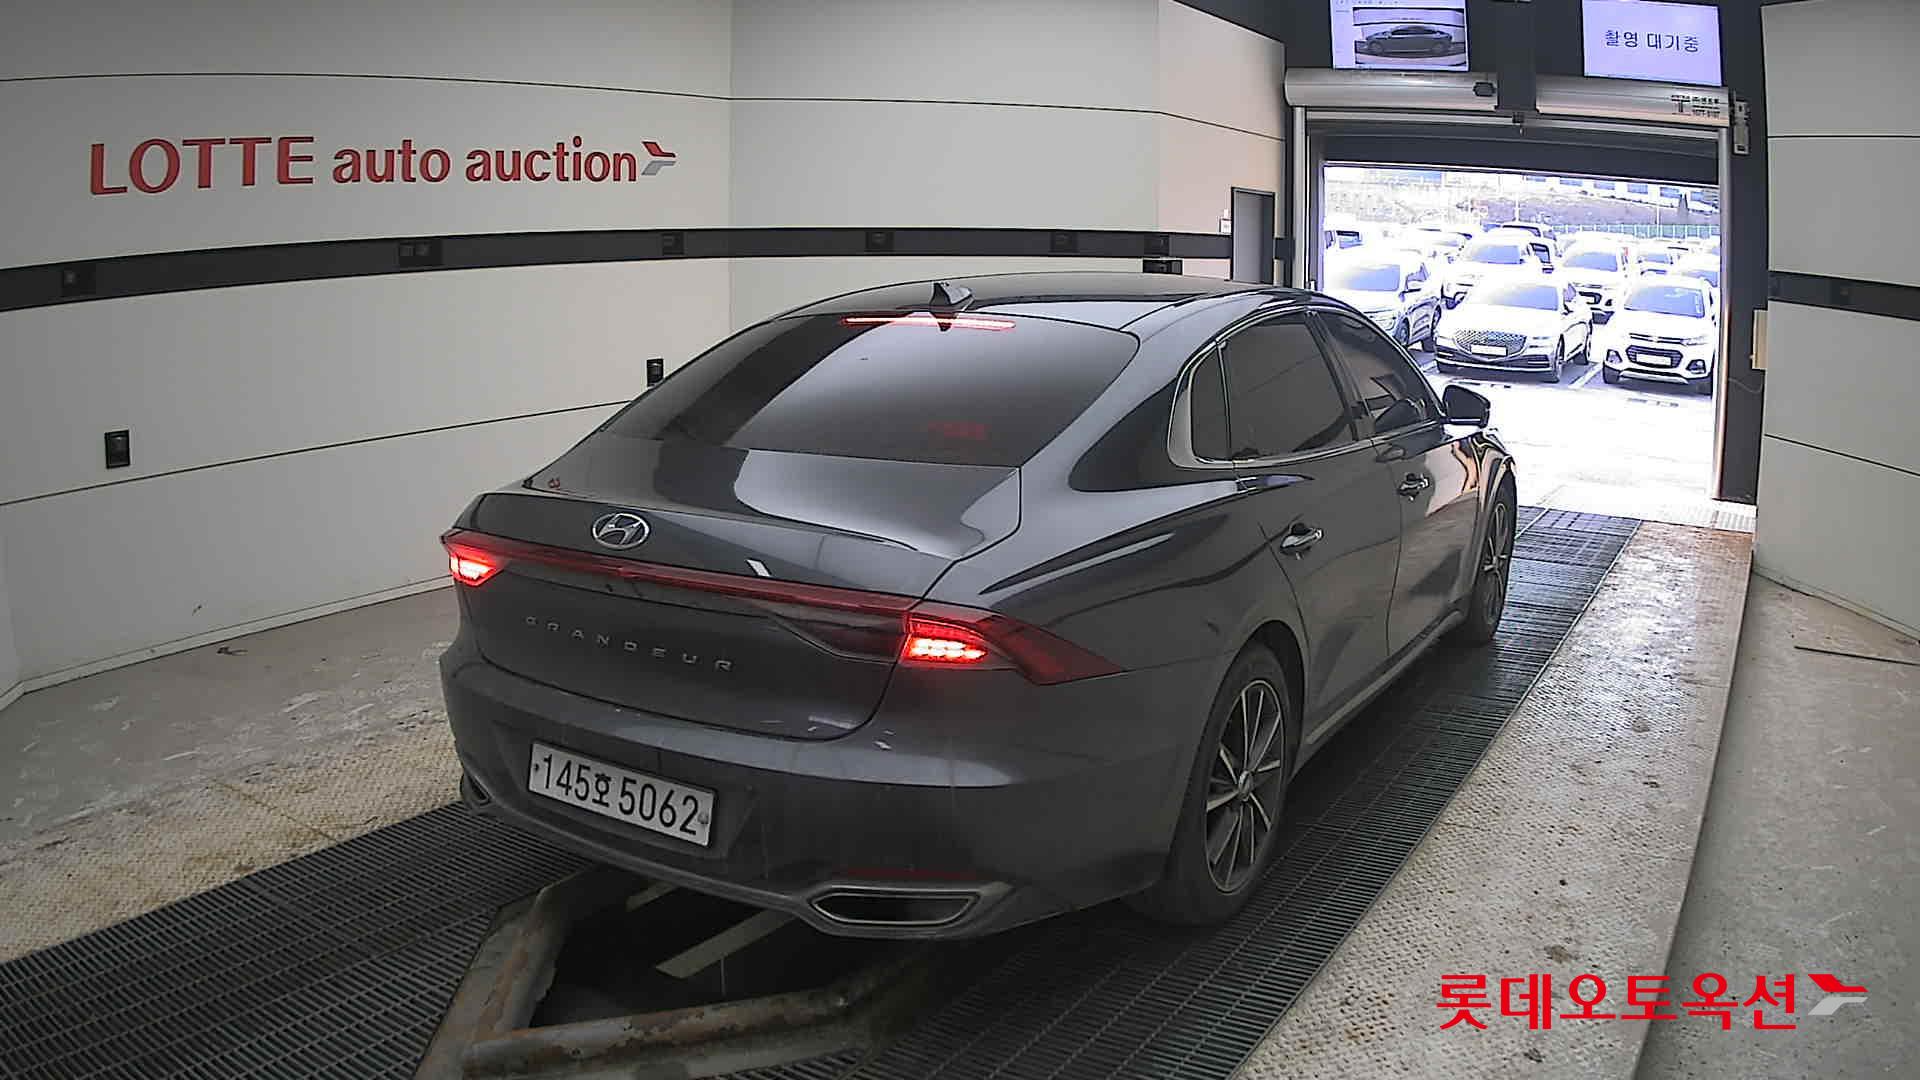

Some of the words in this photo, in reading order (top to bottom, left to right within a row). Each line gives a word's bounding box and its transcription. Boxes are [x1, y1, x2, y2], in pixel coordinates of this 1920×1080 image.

[1605, 29, 1638, 49] 촬영
[1646, 32, 1699, 53] 대기중
[89, 135, 315, 196] LOTTE
[332, 139, 451, 184] auto
[464, 135, 638, 182] auction
[542, 753, 612, 808] 145호
[618, 775, 699, 836] 5062
